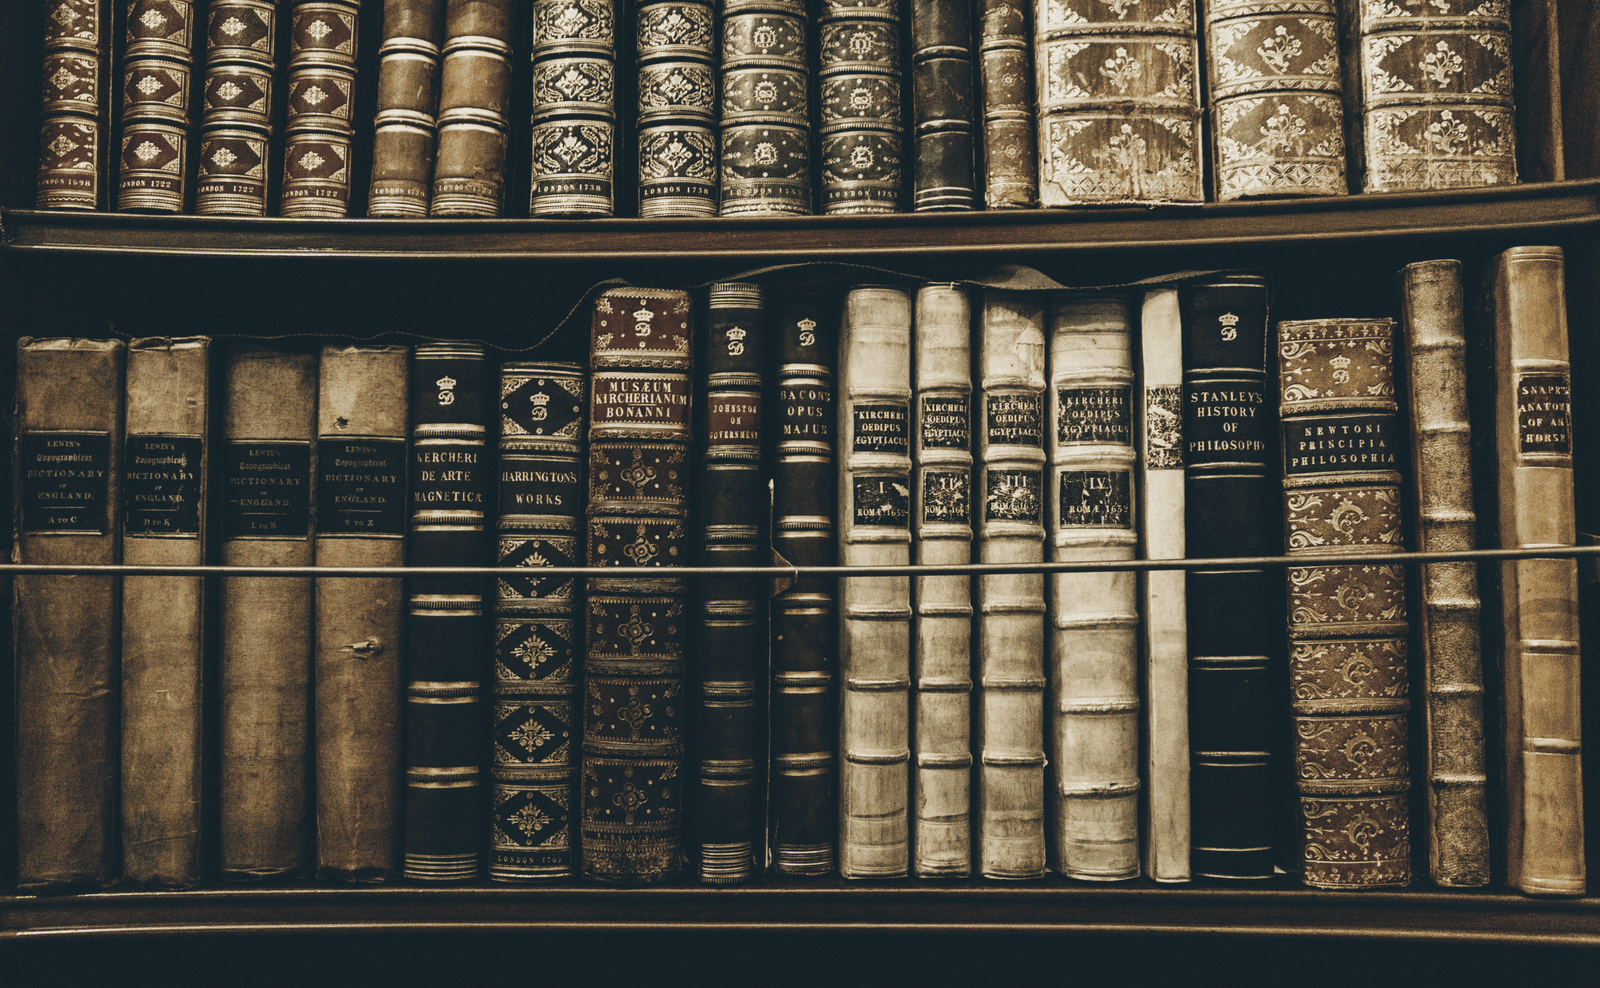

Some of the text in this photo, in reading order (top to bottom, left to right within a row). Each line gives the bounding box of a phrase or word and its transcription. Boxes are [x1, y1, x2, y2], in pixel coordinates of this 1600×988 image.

[68, 178, 90, 186] 1698
[538, 184, 574, 193] LONDON
[644, 186, 681, 196] LONDON
[830, 190, 870, 198] LONDON
[610, 382, 672, 392] MUSÆUM
[596, 393, 688, 405] KIRCHERIANUM
[1067, 396, 1124, 405] KIRCHERI
[1190, 391, 1263, 404] STANLEY'S
[606, 406, 670, 418] BONANNI
[788, 406, 822, 416] OPUS
[926, 404, 966, 412] KIRCHERI
[1197, 406, 1256, 418] HISTORY
[859, 410, 904, 420] KIRCHERI
[996, 414, 1036, 422] OEDIPUS
[1072, 410, 1120, 418] OEDIPUS
[930, 416, 966, 424] OEDIPUS
[1528, 418, 1542, 426] OF
[784, 424, 827, 434] MAJUS
[862, 422, 901, 432] OEDIPUS
[1223, 422, 1238, 432] OF
[1304, 424, 1381, 436] NEWTONI
[1525, 434, 1566, 442] HORSE
[1189, 440, 1265, 452] PHILOSOPHY
[1300, 440, 1386, 450] PRINCIPIA
[1292, 454, 1396, 466] PHILOSOPHIÆ
[27, 470, 104, 478] DICTIONARY
[127, 472, 194, 480] DICTIONARY
[326, 474, 396, 482] DICTIONARY
[422, 470, 471, 481] DE ARTE
[230, 478, 300, 486] DICTIONARY
[516, 494, 562, 506] WORKS
[858, 508, 882, 516] ROMÆ
[498, 855, 534, 864] LONDON
